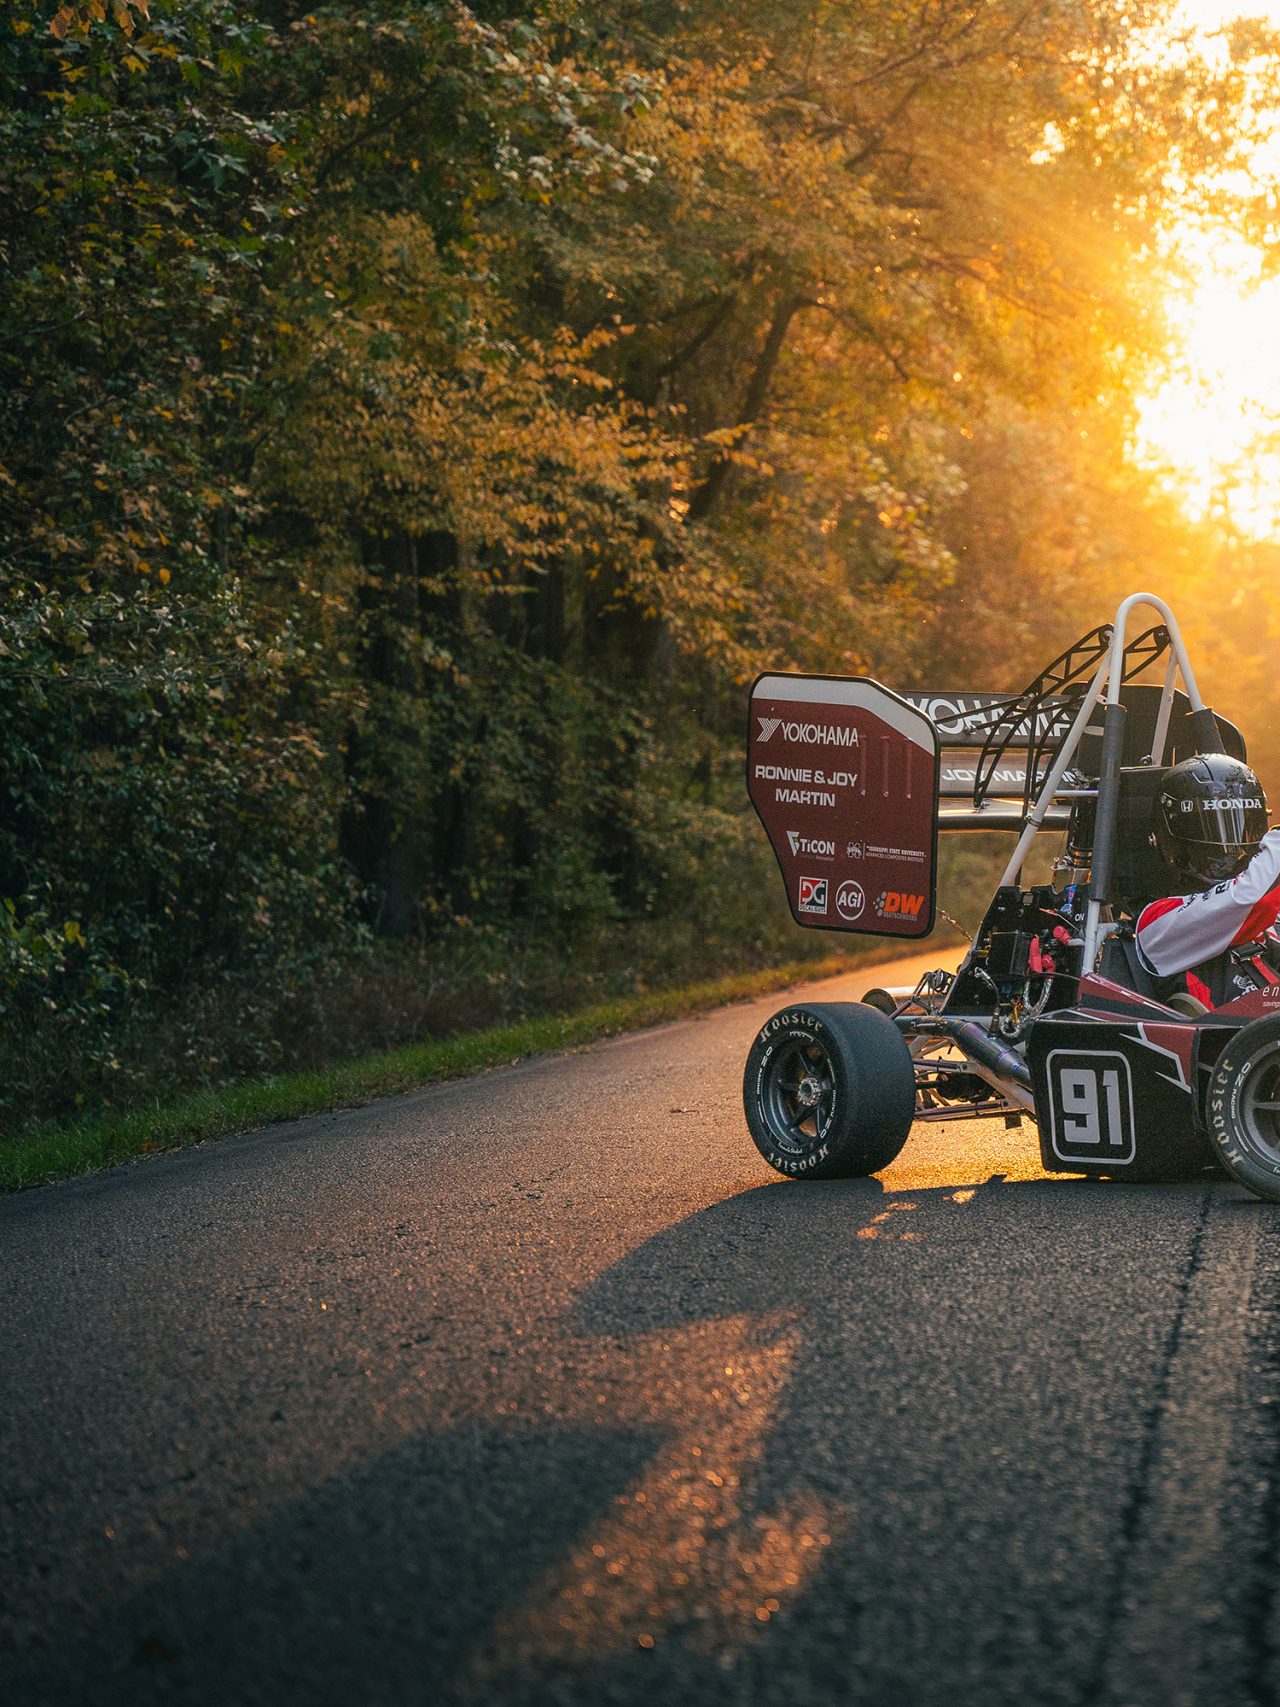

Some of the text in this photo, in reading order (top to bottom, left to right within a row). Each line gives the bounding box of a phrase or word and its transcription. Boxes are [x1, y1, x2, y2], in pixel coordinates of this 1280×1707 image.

[781, 722, 859, 747] YOKOHAMA
[755, 765, 858, 787] RONNIE & JOY
[775, 788, 836, 807] MARTIN
[1202, 798, 1263, 811] HONDA
[838, 890, 862, 908] AGI
[884, 891, 925, 915] DW
[1074, 913, 1085, 922] ON
[759, 1012, 822, 1044] Hoosier
[1060, 1068, 1123, 1145] 91
[1211, 1059, 1245, 1167] Hoosier
[767, 1143, 829, 1172] Hoosier
